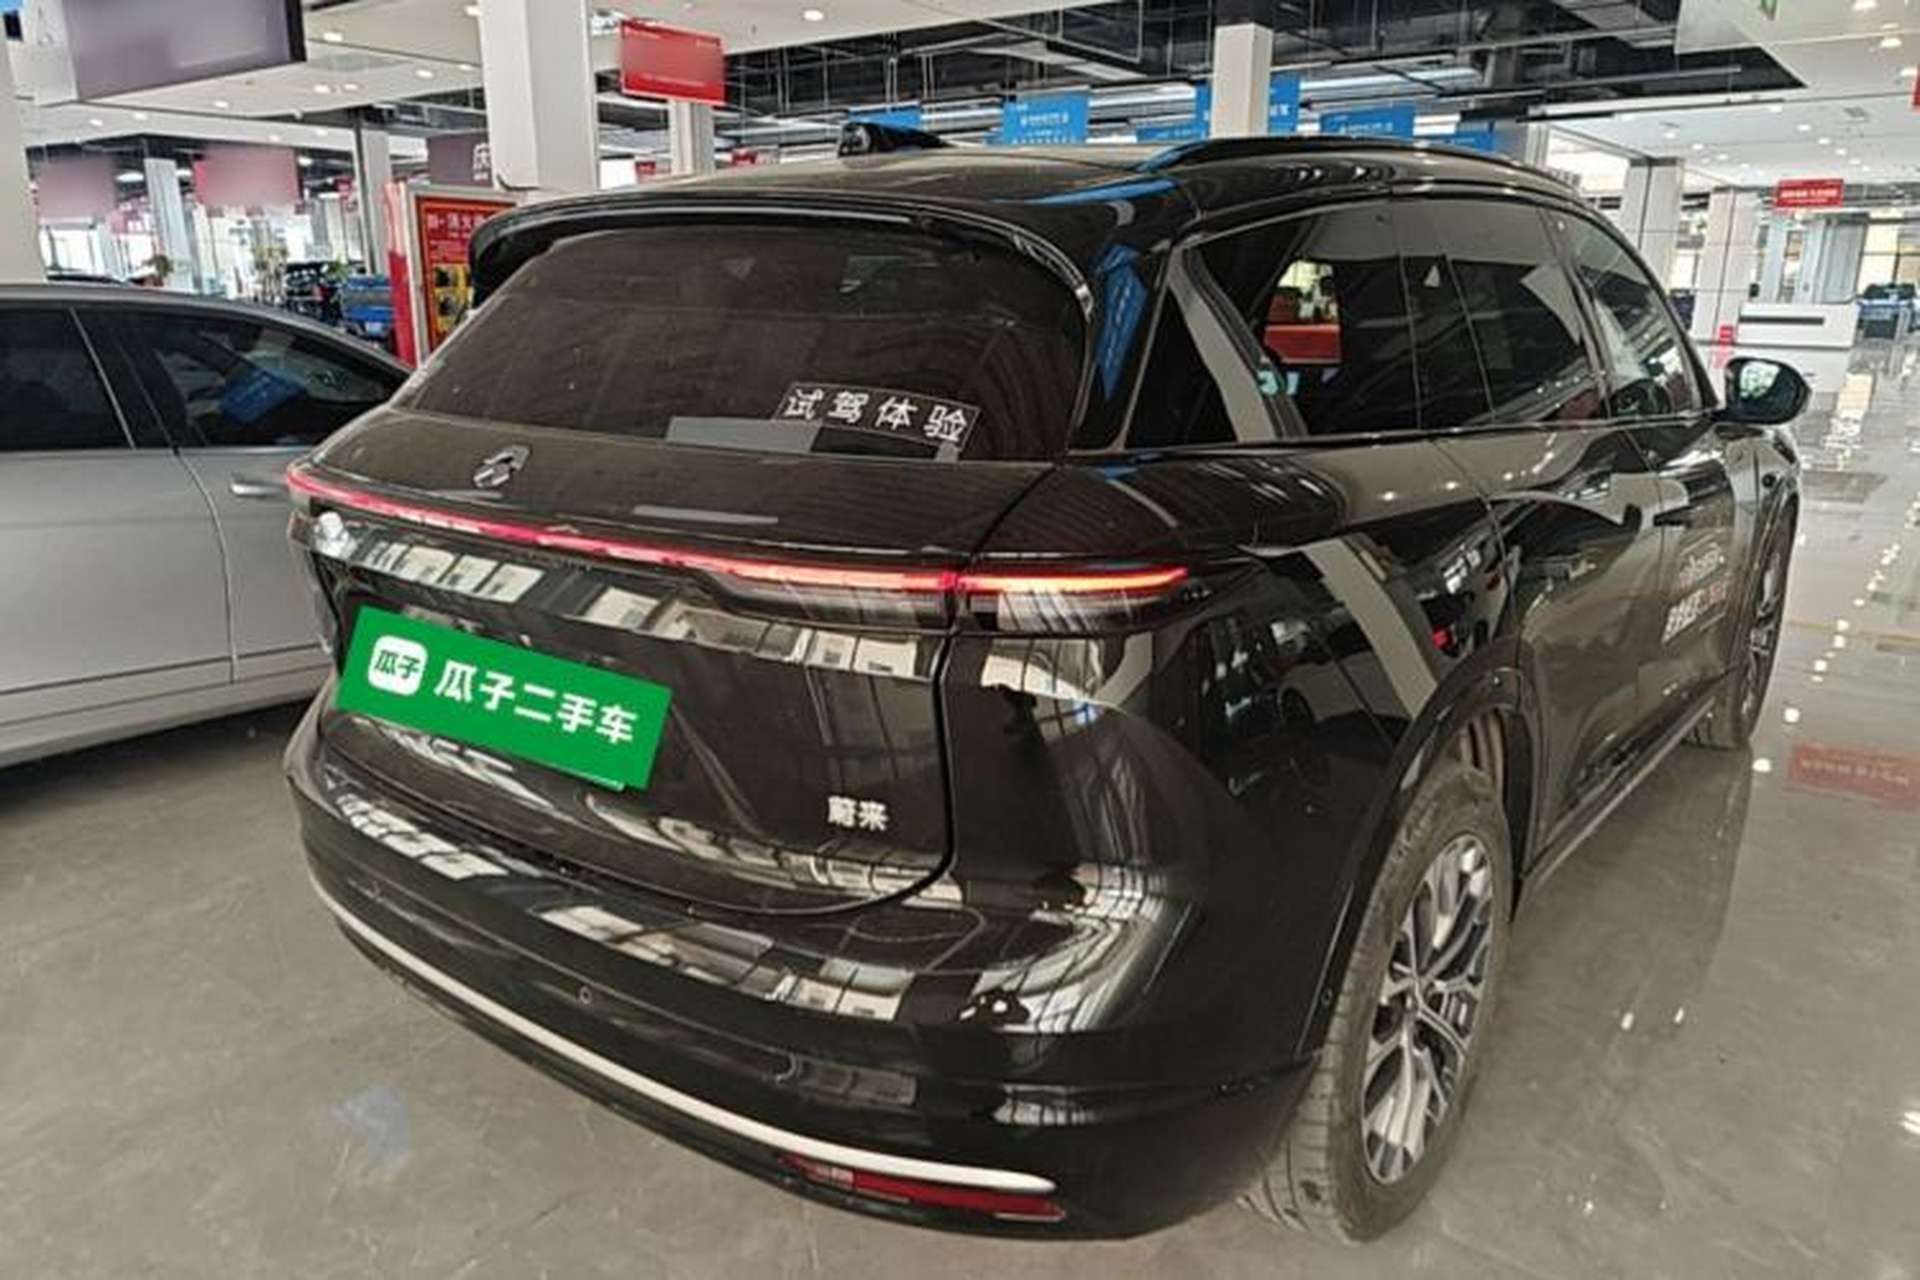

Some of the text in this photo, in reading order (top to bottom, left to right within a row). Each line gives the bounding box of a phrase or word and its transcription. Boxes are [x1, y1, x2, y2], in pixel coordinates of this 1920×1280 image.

[784, 388, 967, 442] 试驾体验
[828, 796, 888, 831] 蔚来
